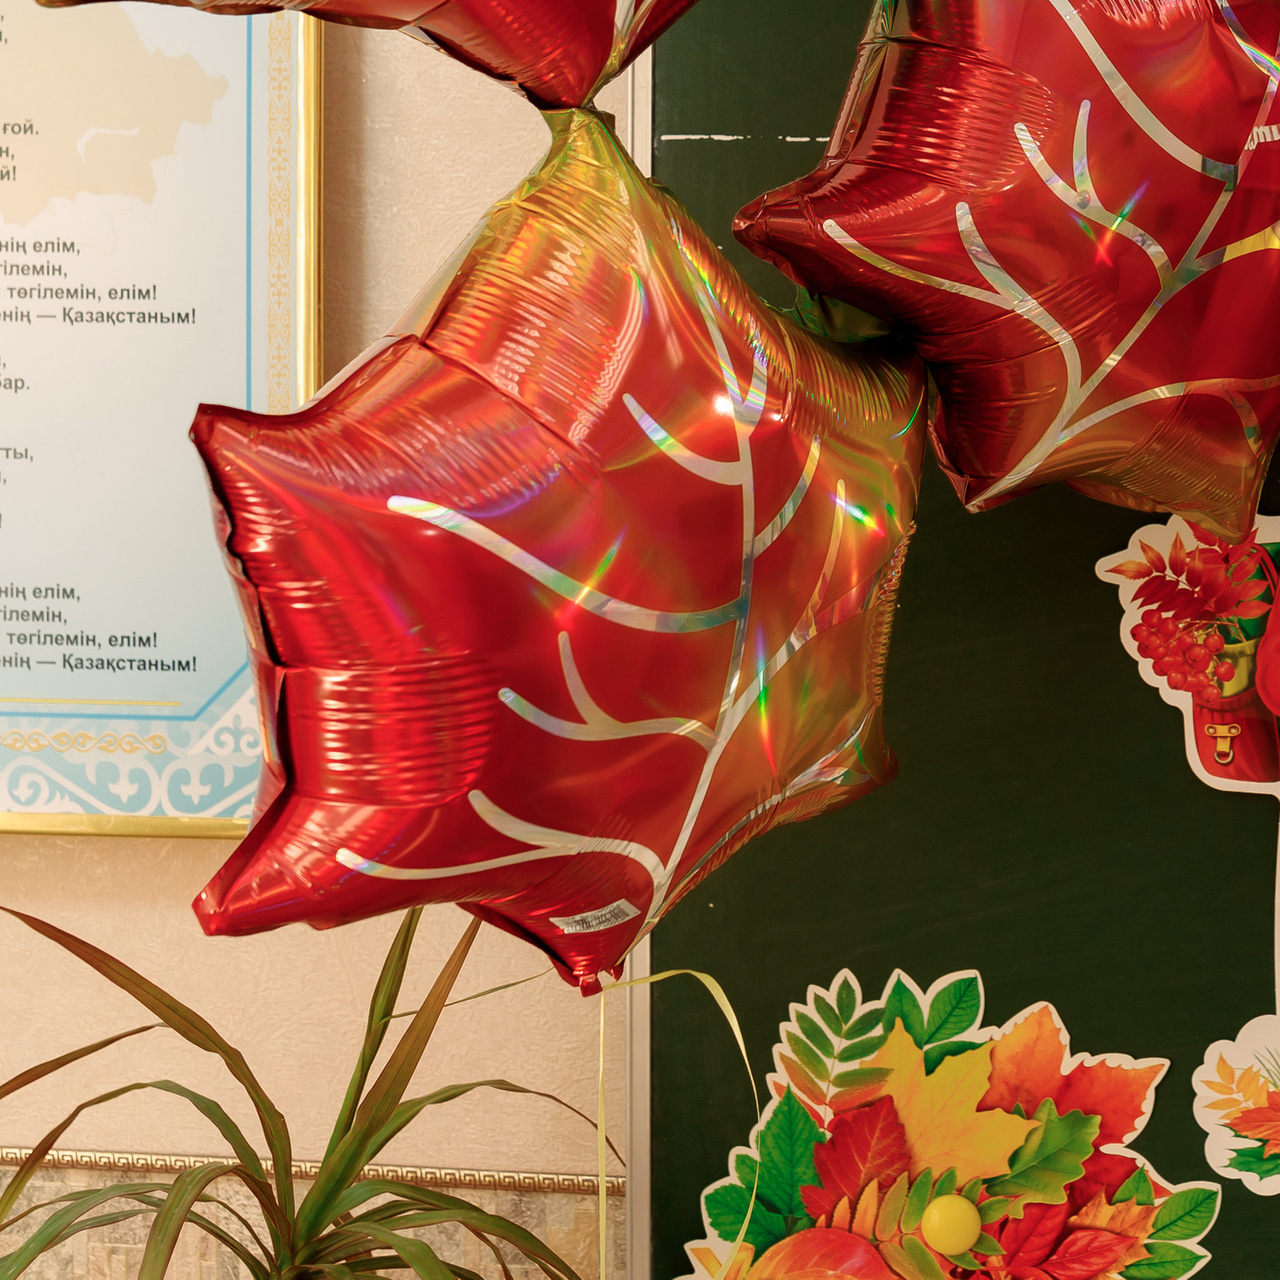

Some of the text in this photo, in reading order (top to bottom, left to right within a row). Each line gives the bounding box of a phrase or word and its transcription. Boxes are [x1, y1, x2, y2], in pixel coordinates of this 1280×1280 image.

[32, 236, 81, 257] елім,
[0, 260, 68, 280] ілемін,
[7, 283, 157, 304] төгілемін, елім!
[0, 306, 32, 326] нің
[62, 306, 197, 326] Қазақстаным!
[32, 583, 81, 603] елім,
[0, 605, 68, 626] ілемін,
[6, 629, 158, 651] төгілемін, елім!
[0, 651, 32, 672] нің
[62, 652, 198, 674] Қазақстаным!
